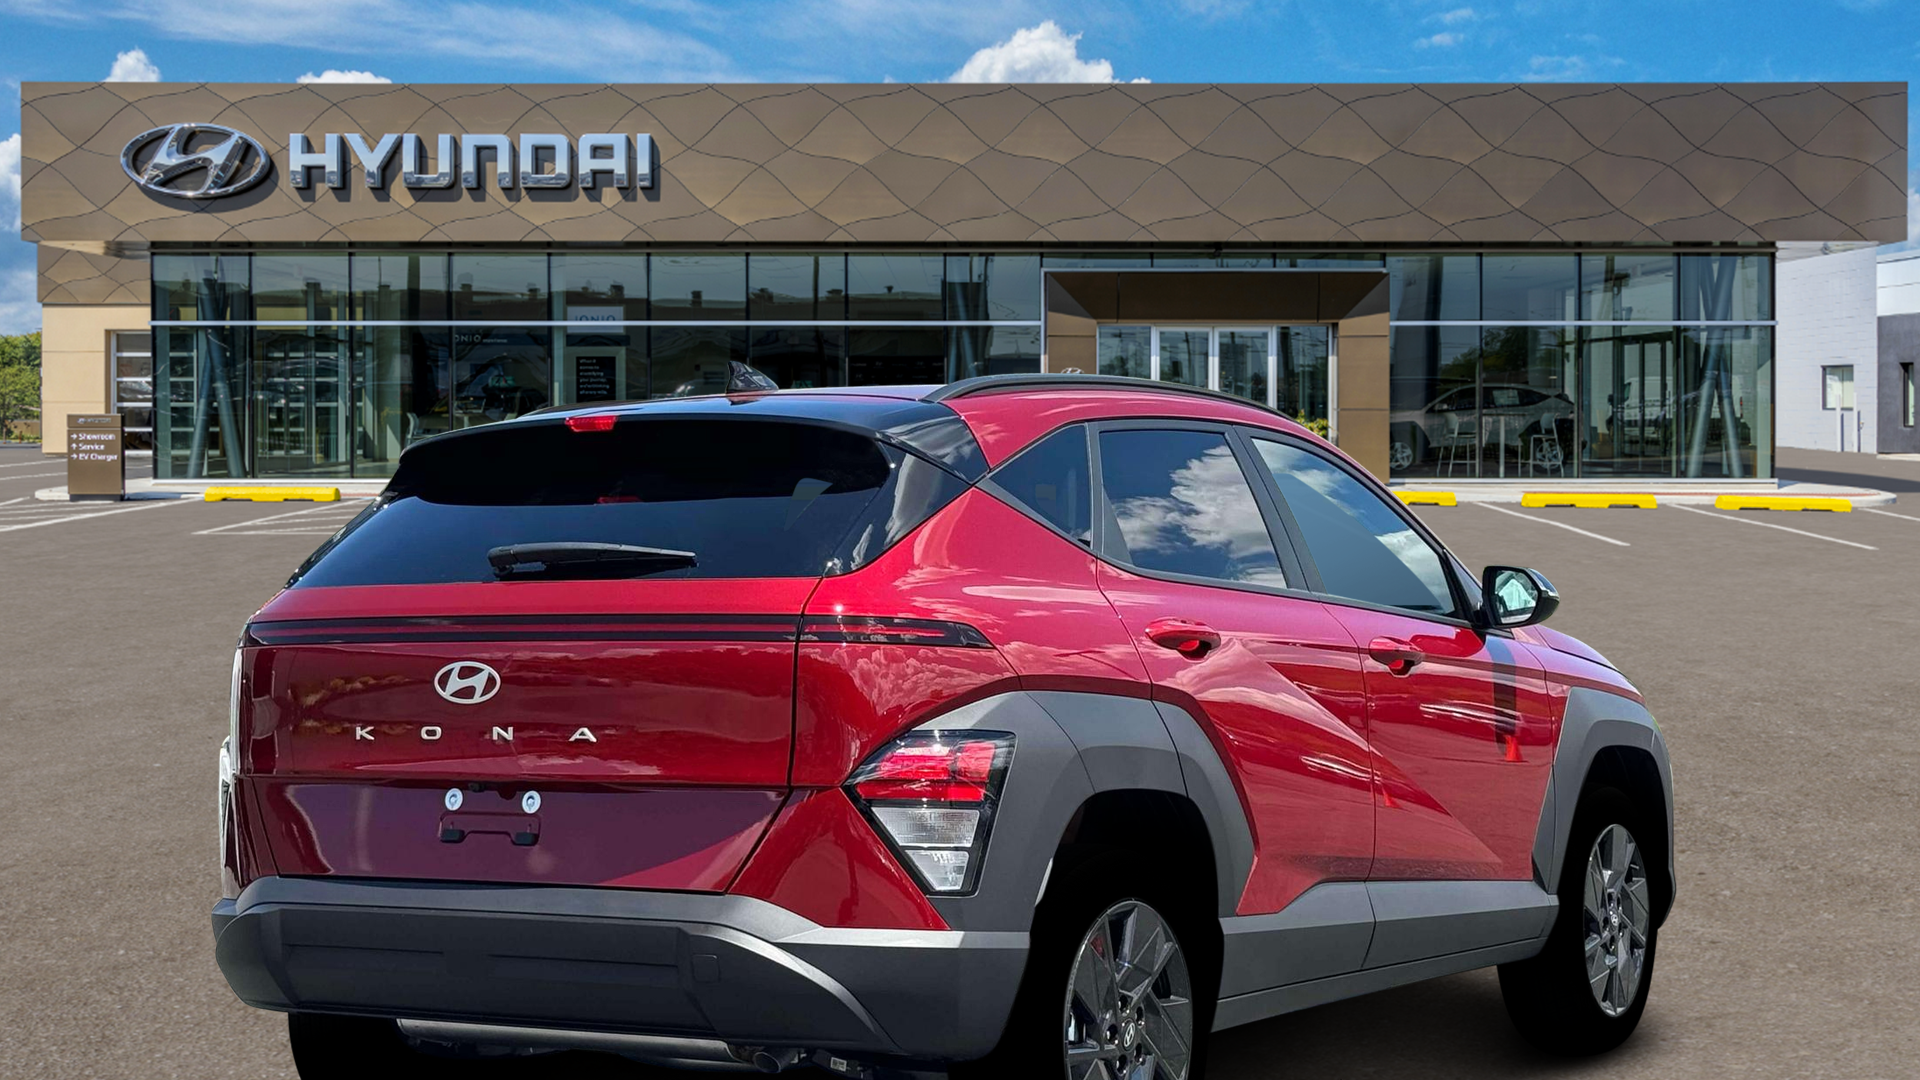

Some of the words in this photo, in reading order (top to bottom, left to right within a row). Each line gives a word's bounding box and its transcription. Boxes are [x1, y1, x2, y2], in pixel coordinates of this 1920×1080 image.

[289, 132, 653, 188] HYUNDAI
[78, 433, 116, 441] Showroom
[78, 442, 105, 450] Service
[90, 453, 118, 462] Charger
[355, 726, 597, 743] KONA
